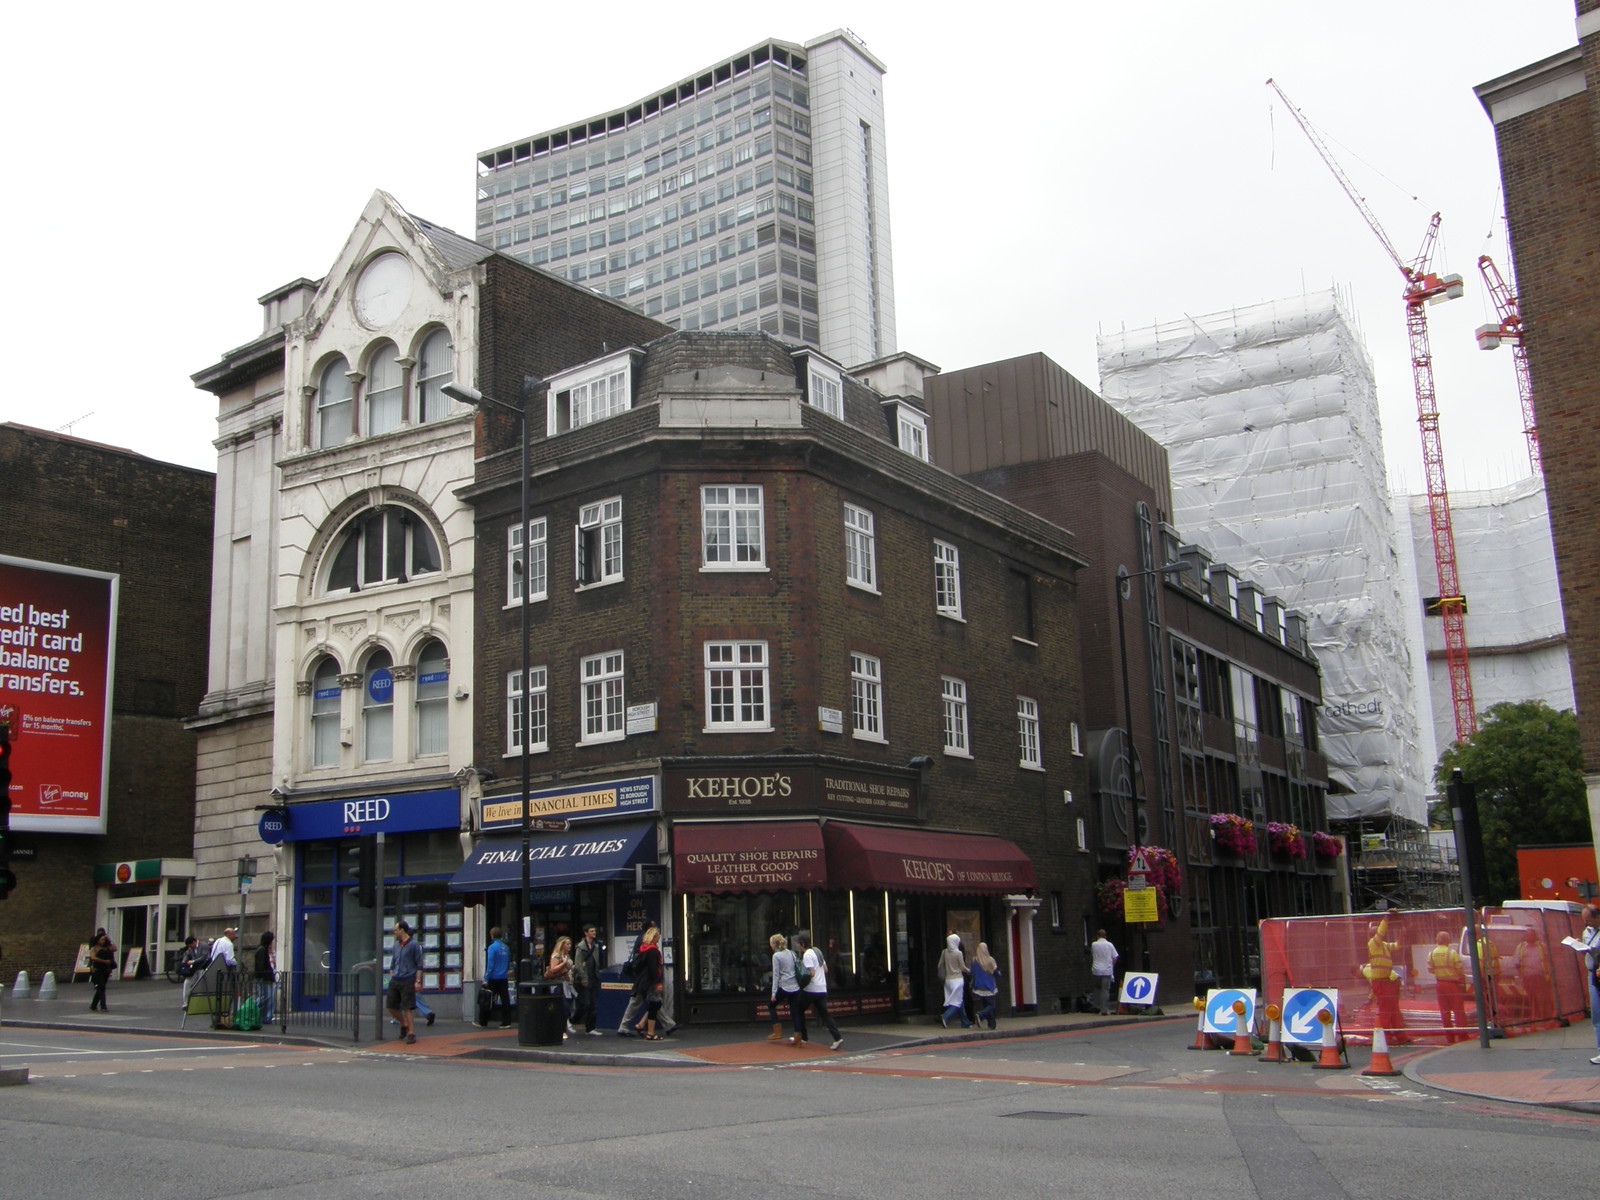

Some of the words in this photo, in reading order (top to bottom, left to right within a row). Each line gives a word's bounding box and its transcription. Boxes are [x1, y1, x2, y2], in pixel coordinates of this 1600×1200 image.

[29, 604, 70, 629] best
[0, 625, 38, 647] edit
[42, 632, 82, 652] card
[0, 645, 70, 673] balance
[0, 672, 84, 696] ransfers.
[372, 678, 391, 689] REED
[1325, 697, 1383, 718] cathedr
[22, 721, 32, 729] for
[23, 714, 33, 722] 0%
[43, 716, 65, 724] balance
[66, 718, 92, 726] transfers
[633, 784, 650, 792] STUDIO
[686, 772, 792, 799] KEHOE'S
[824, 777, 868, 793] TRADITIONAL
[869, 783, 886, 795] SHOE
[886, 785, 910, 798] REPAIRS
[62, 791, 89, 801] money
[625, 791, 648, 799] BOROUGH
[632, 797, 649, 805] STREET
[344, 798, 391, 823] REED
[486, 806, 497, 818] We
[498, 805, 512, 817] live
[513, 804, 522, 816] in
[530, 796, 579, 814] INANCIAL
[581, 792, 614, 807] TIMES
[264, 821, 283, 831] REED
[570, 838, 628, 856] TIMES
[687, 853, 736, 864] QUALITY
[739, 851, 769, 861] SHOE
[772, 849, 818, 860] REPAIRS
[707, 863, 758, 874] LEATHER
[760, 861, 799, 872] GOODS
[902, 858, 954, 882] KEHOE'S
[957, 871, 965, 882] OF
[966, 871, 991, 882] LONDON
[991, 871, 1013, 882] BRIDGE
[715, 875, 737, 885] KEY
[741, 873, 792, 883] CUTTING
[530, 889, 571, 901] EWSAGENT
[630, 898, 643, 908] ON
[626, 909, 647, 920] SALE
[626, 921, 643, 931] HER
